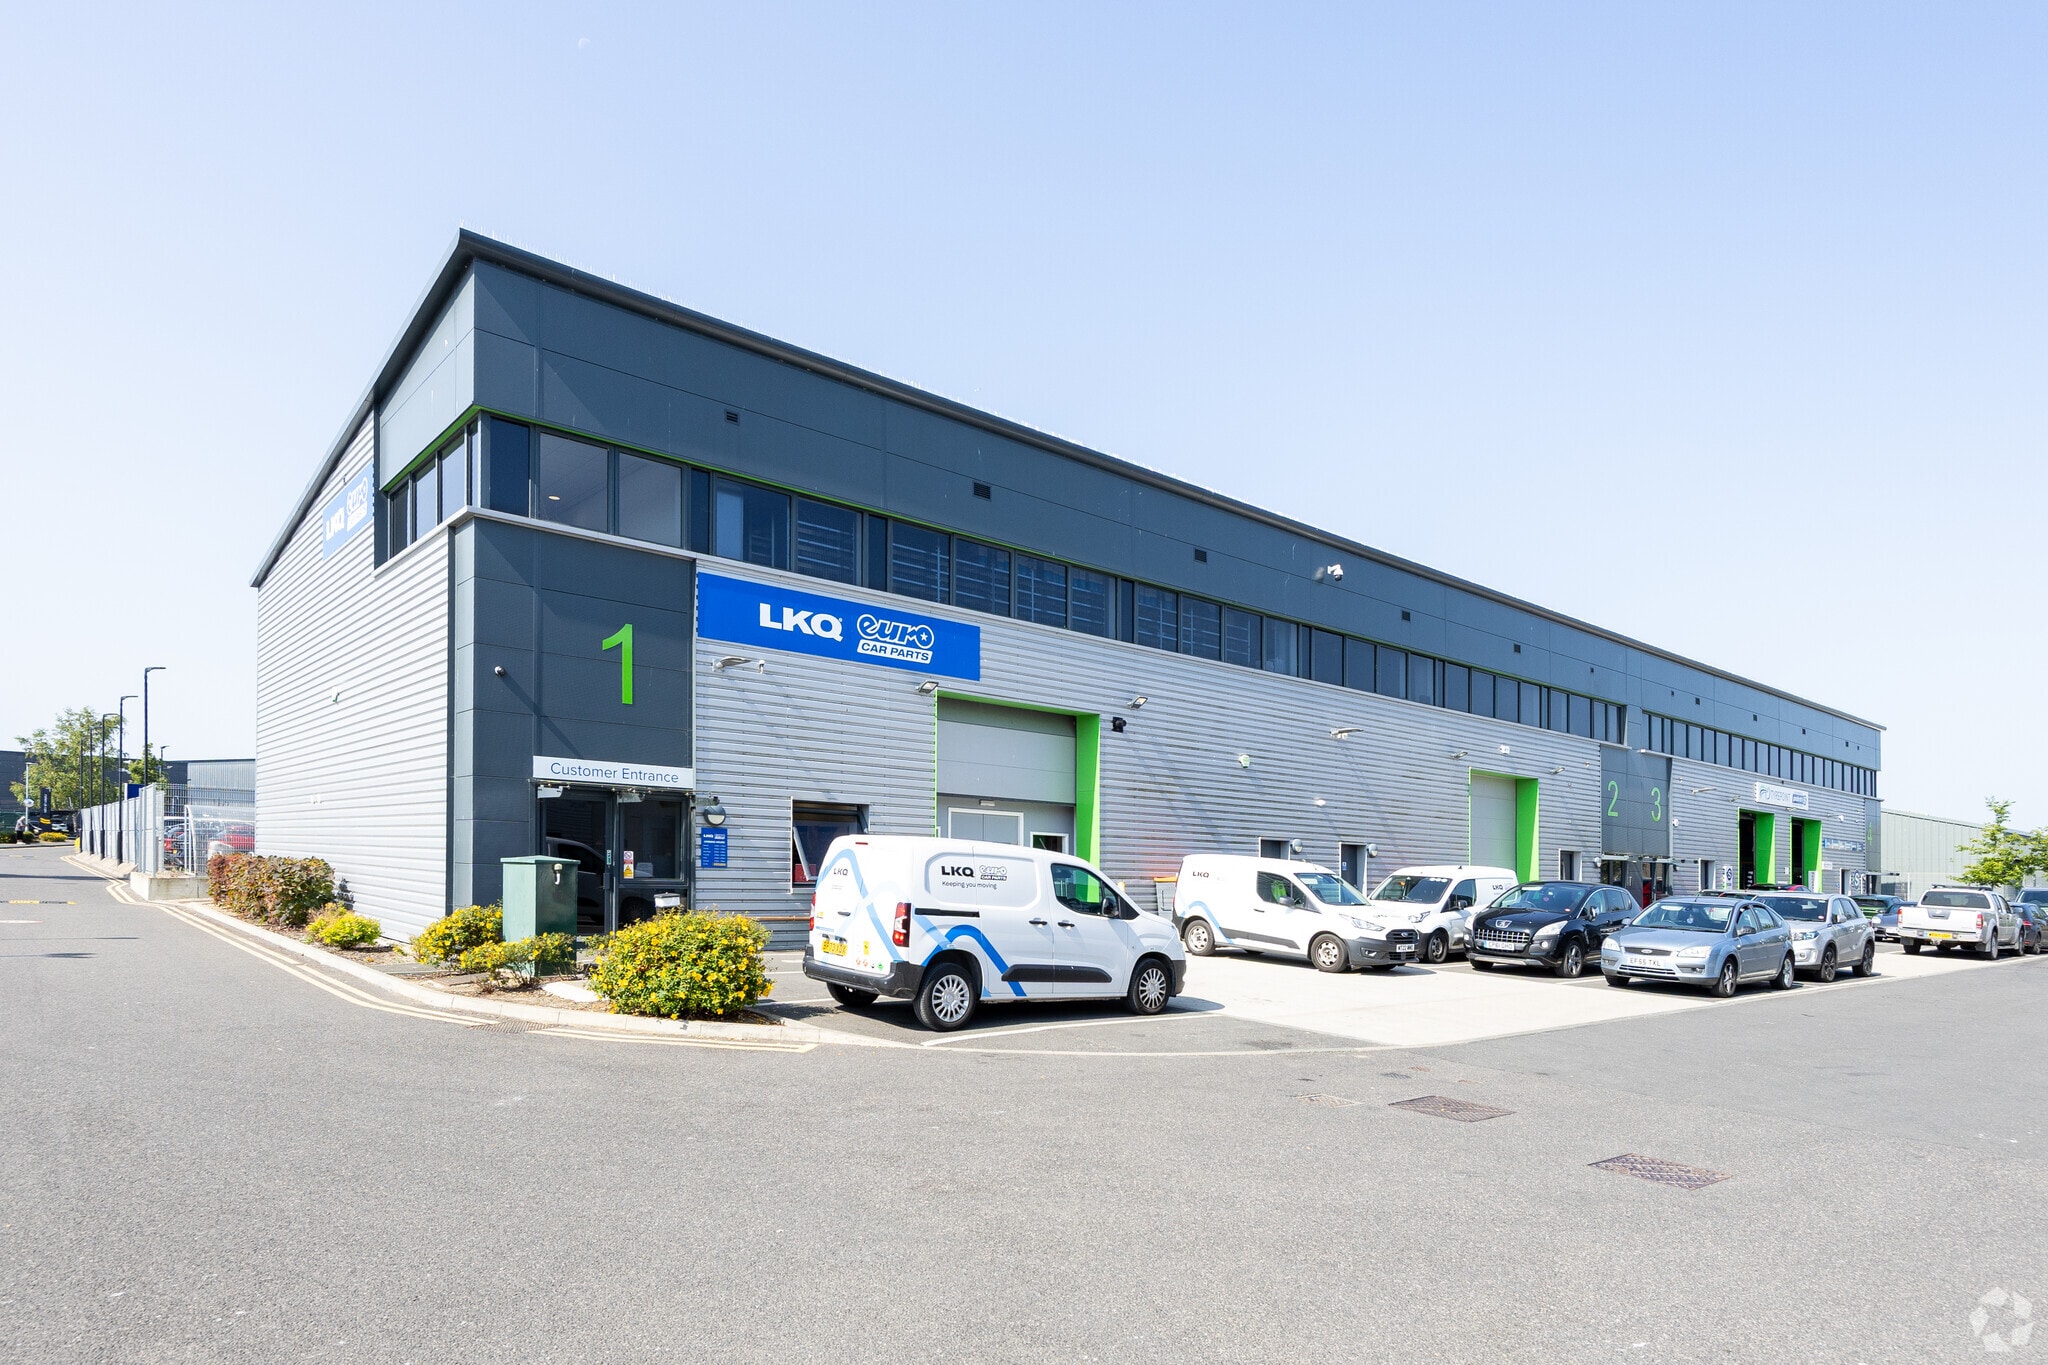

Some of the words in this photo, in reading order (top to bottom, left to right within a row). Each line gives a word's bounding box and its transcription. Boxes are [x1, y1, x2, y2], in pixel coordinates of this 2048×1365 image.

[760, 602, 843, 642] LKQ
[857, 614, 934, 649] euro
[861, 642, 887, 654] CAR
[890, 648, 929, 661] PARTS
[602, 623, 632, 705] 1
[550, 762, 617, 779] Customer
[622, 767, 679, 783] Entrance
[1608, 780, 1618, 817] 2
[1651, 787, 1661, 823] 3
[832, 867, 849, 876] LKQ
[941, 865, 975, 878] LKQ
[941, 881, 965, 889] Keeping
